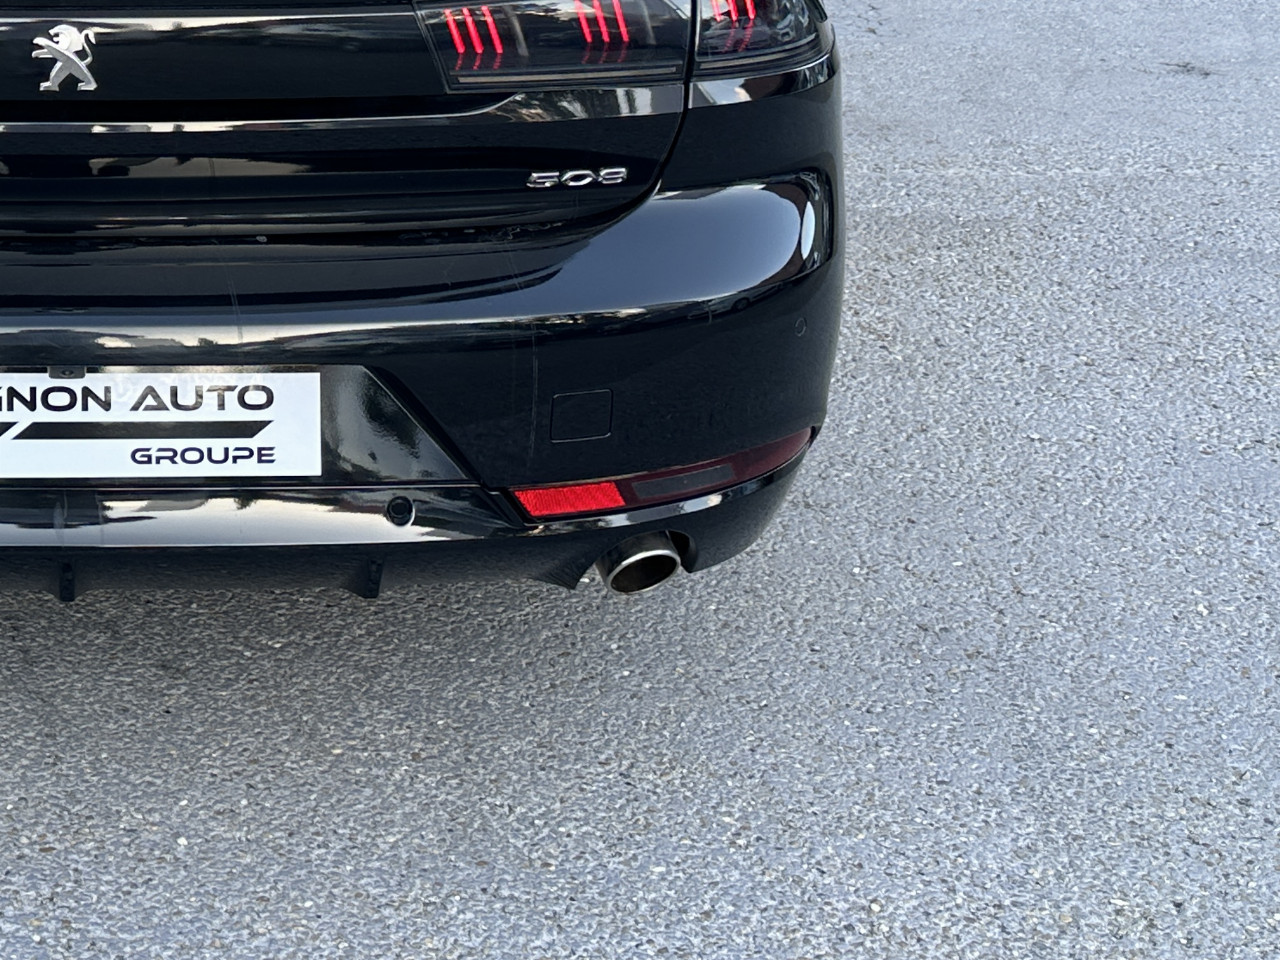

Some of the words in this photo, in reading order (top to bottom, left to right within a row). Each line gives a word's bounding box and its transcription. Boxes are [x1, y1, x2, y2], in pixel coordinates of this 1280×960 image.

[526, 167, 627, 188] 508
[129, 385, 275, 412] AUTO
[130, 446, 276, 465] GROUPE
